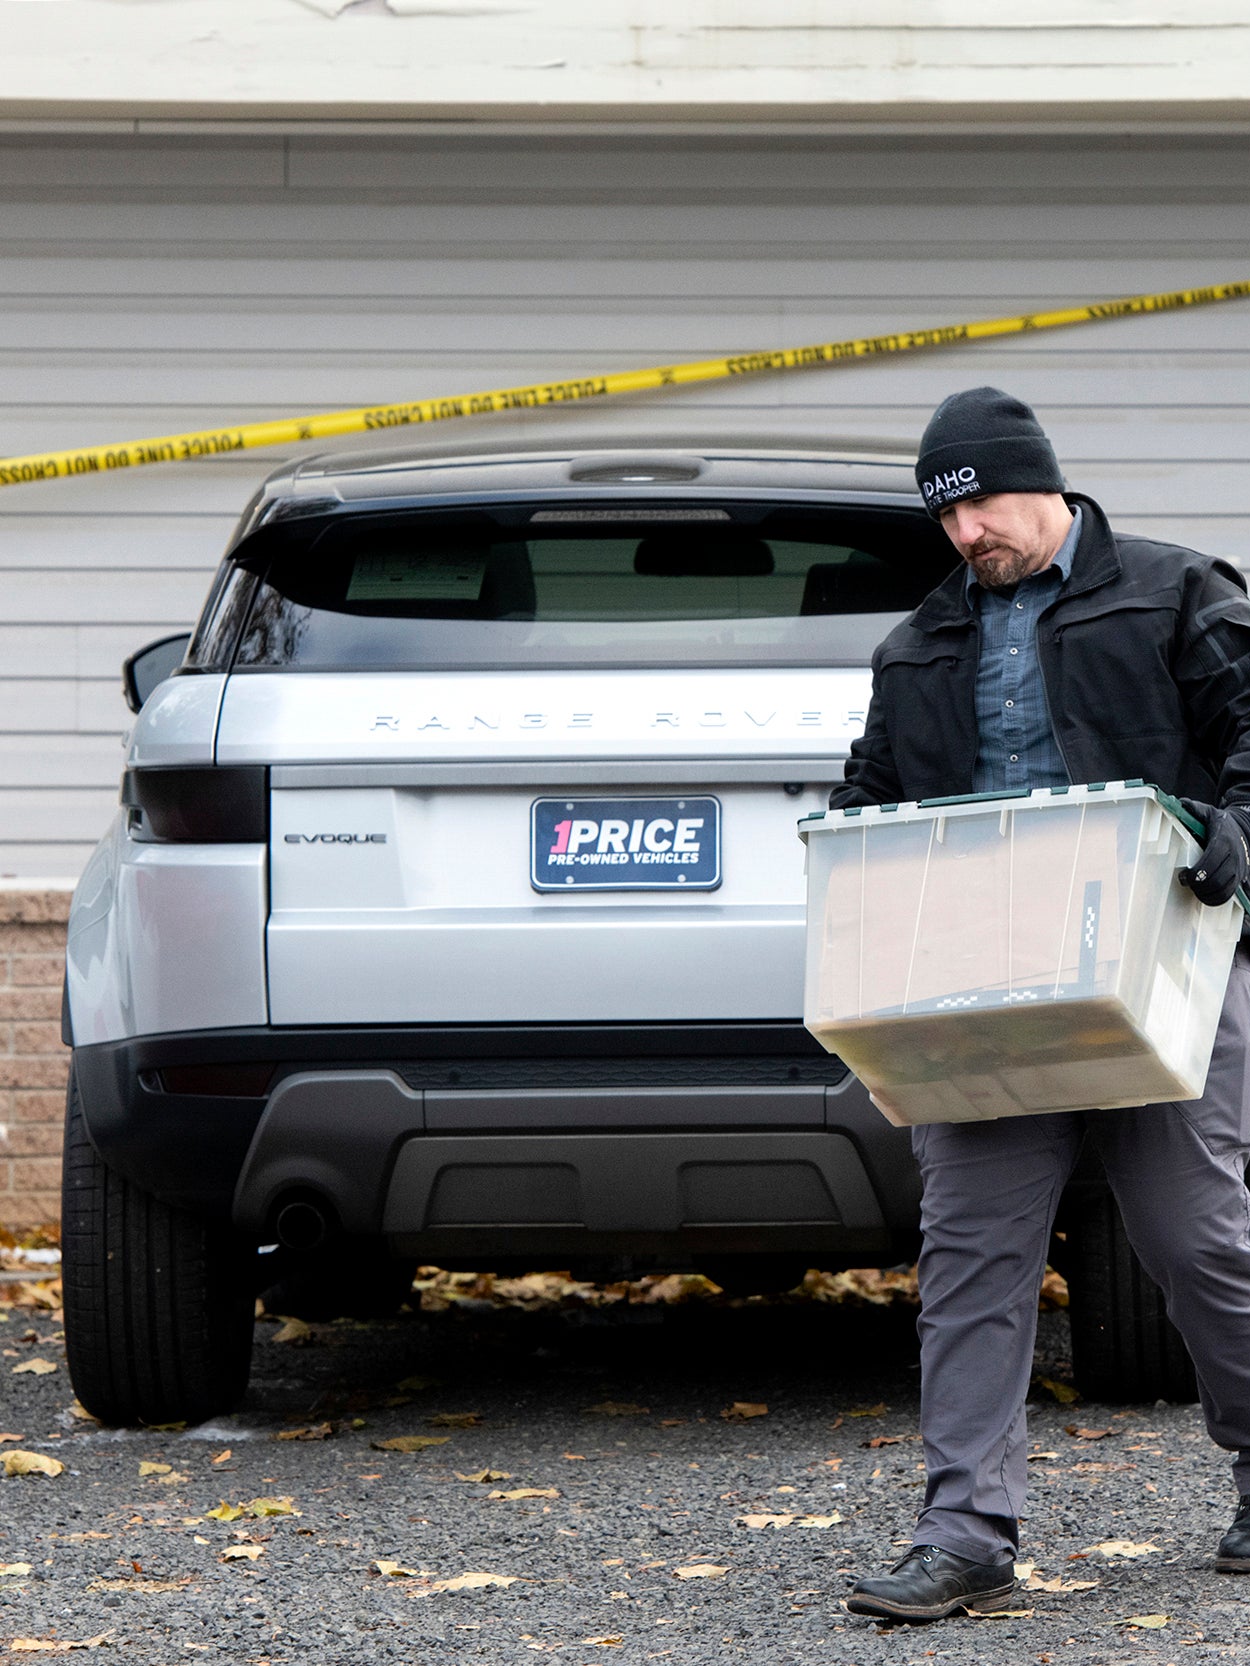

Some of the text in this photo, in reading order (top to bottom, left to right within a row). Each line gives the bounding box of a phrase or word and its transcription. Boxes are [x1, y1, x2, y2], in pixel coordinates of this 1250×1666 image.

[545, 377, 606, 401] POLICE
[430, 401, 464, 420] NOT
[468, 395, 495, 413] DO
[363, 405, 424, 430] CROSS
[0, 434, 244, 485] POLICE LINE DO NOT CROSS
[944, 481, 981, 501] TROOPER
[370, 713, 593, 730] RANGE
[284, 833, 387, 845] EVOQUE
[547, 852, 699, 866] PRE-OWNED VEHICLES
